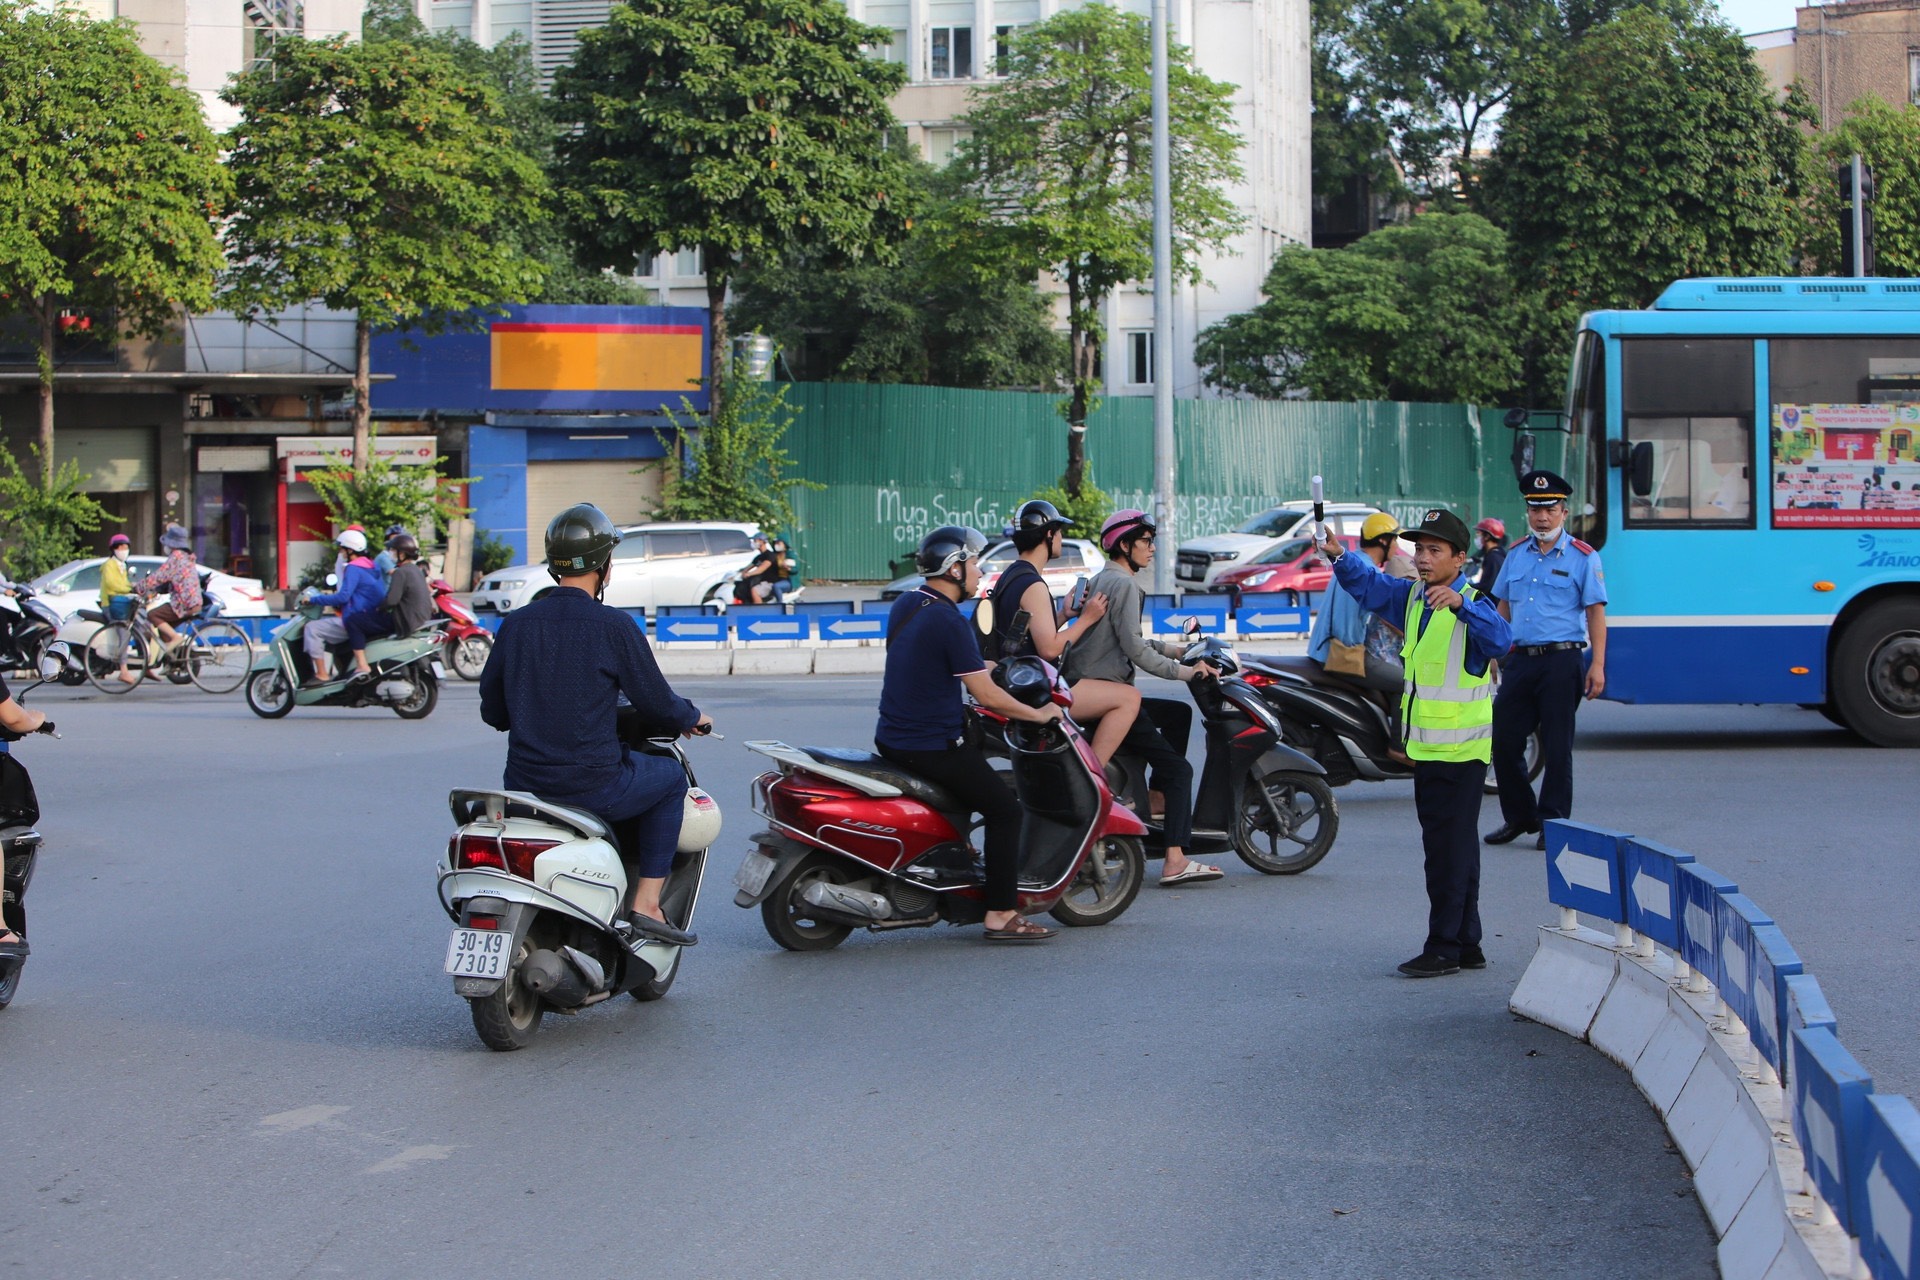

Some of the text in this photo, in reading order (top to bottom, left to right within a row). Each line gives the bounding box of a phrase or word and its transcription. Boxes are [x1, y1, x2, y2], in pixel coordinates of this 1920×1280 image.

[840, 818, 898, 834] LEAD
[571, 867, 611, 880] LEAD
[458, 931, 503, 953] 30-K9
[453, 953, 499, 975] 7303
